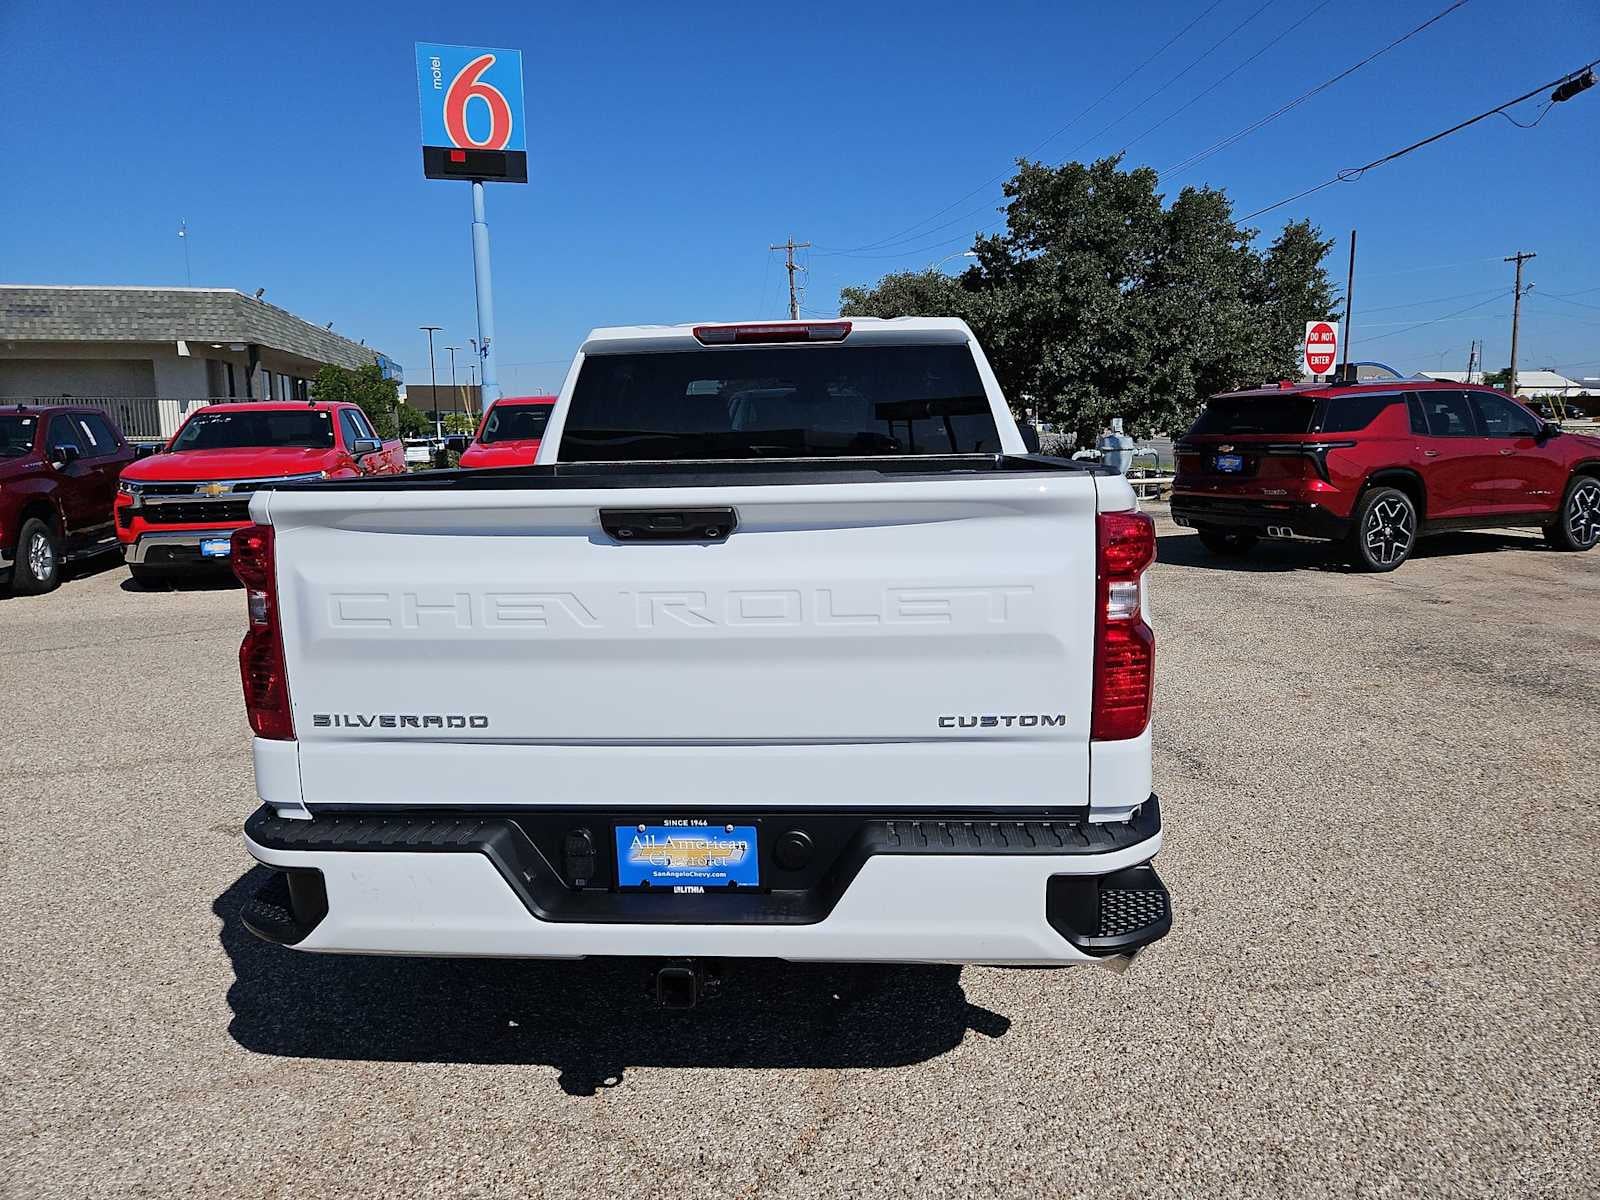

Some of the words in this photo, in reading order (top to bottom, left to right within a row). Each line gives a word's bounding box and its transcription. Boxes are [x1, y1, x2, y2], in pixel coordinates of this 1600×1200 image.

[429, 56, 442, 90] motel
[443, 53, 513, 150] 6
[1310, 332, 1319, 341] DO
[1321, 332, 1333, 341] NOT
[1311, 356, 1330, 364] ENTER
[328, 585, 1036, 629] CHEVROLET
[313, 714, 489, 728] SILVERADO
[938, 715, 1066, 728] CUSTOM
[630, 835, 655, 849] All
[664, 835, 748, 850] American
[649, 851, 728, 867] Chevrolet
[681, 886, 705, 894] LITHIA
